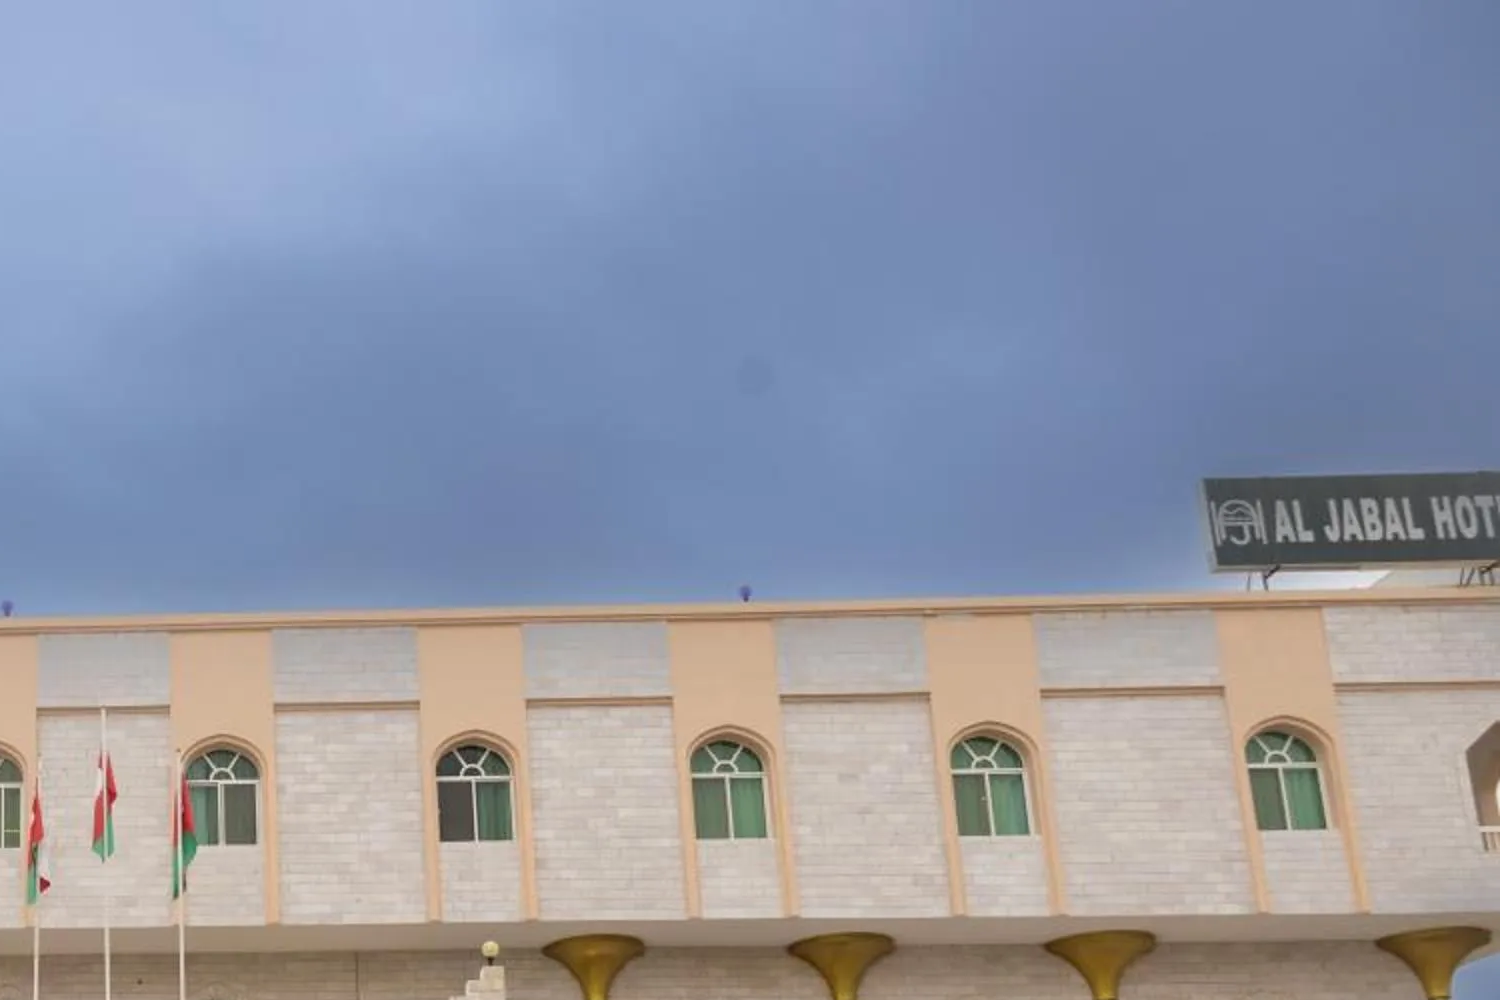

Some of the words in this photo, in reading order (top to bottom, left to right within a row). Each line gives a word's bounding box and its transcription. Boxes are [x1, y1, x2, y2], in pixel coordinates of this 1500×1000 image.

[1274, 499, 1315, 542] AL
[1324, 497, 1425, 542] JABAL
[1429, 494, 1500, 540] HOT
